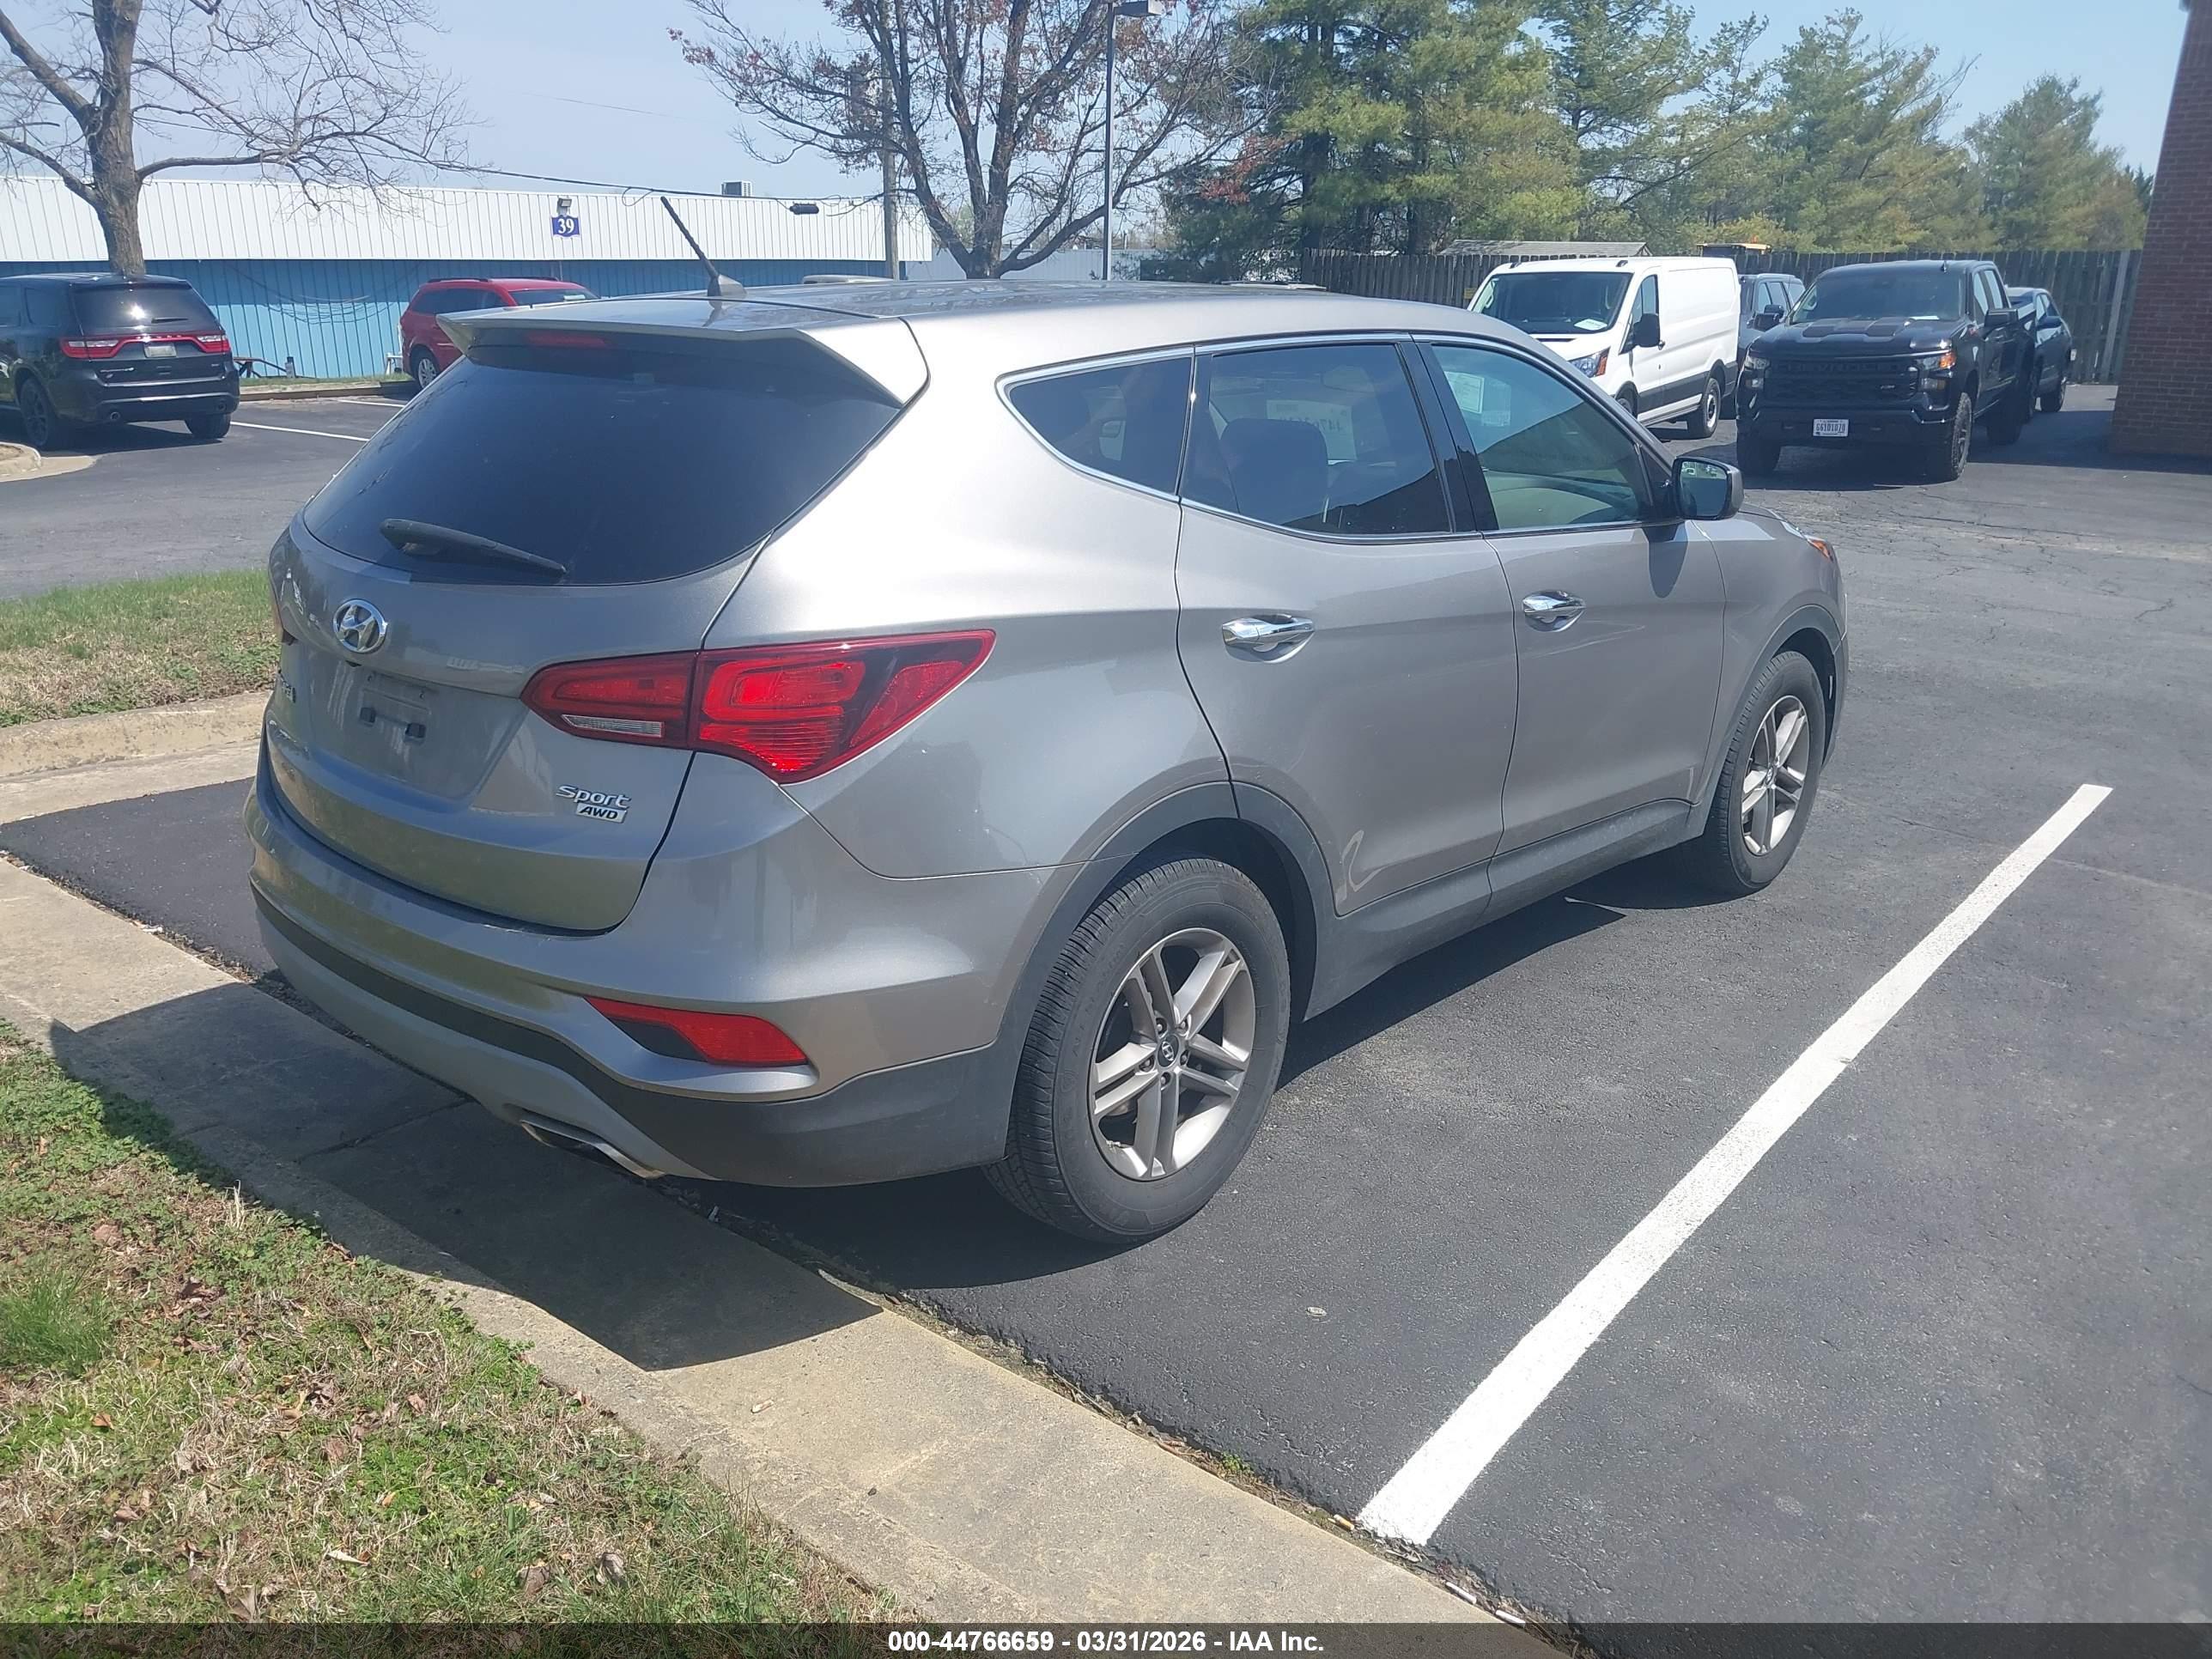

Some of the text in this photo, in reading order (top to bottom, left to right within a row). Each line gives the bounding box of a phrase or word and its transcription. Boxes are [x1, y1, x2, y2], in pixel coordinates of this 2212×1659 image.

[557, 218, 574, 234] 39
[556, 785, 632, 809] Sport
[579, 805, 619, 820] AWD
